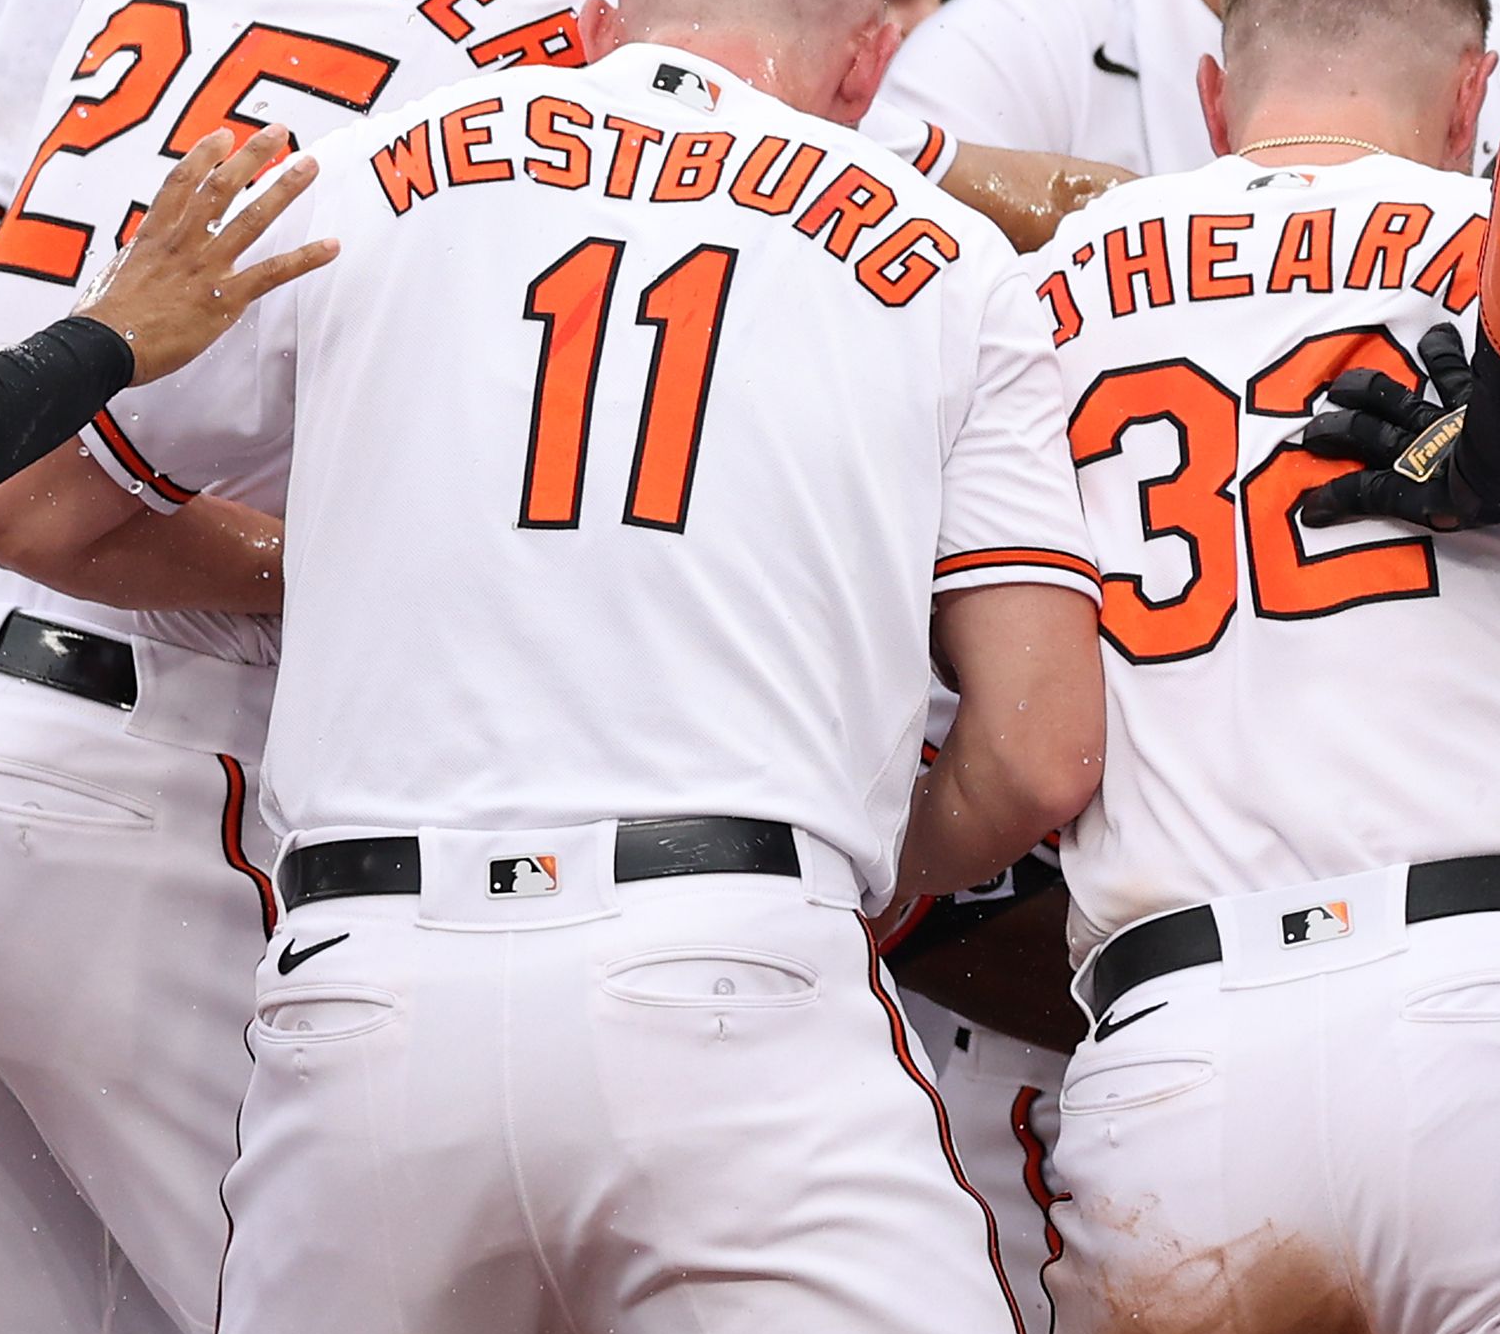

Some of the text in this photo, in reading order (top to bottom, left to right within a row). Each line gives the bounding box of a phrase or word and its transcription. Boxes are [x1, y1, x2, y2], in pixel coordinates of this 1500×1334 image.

[371, 95, 959, 307] WESTBURG
[518, 236, 738, 532] 11
[1067, 325, 1440, 665] 32
